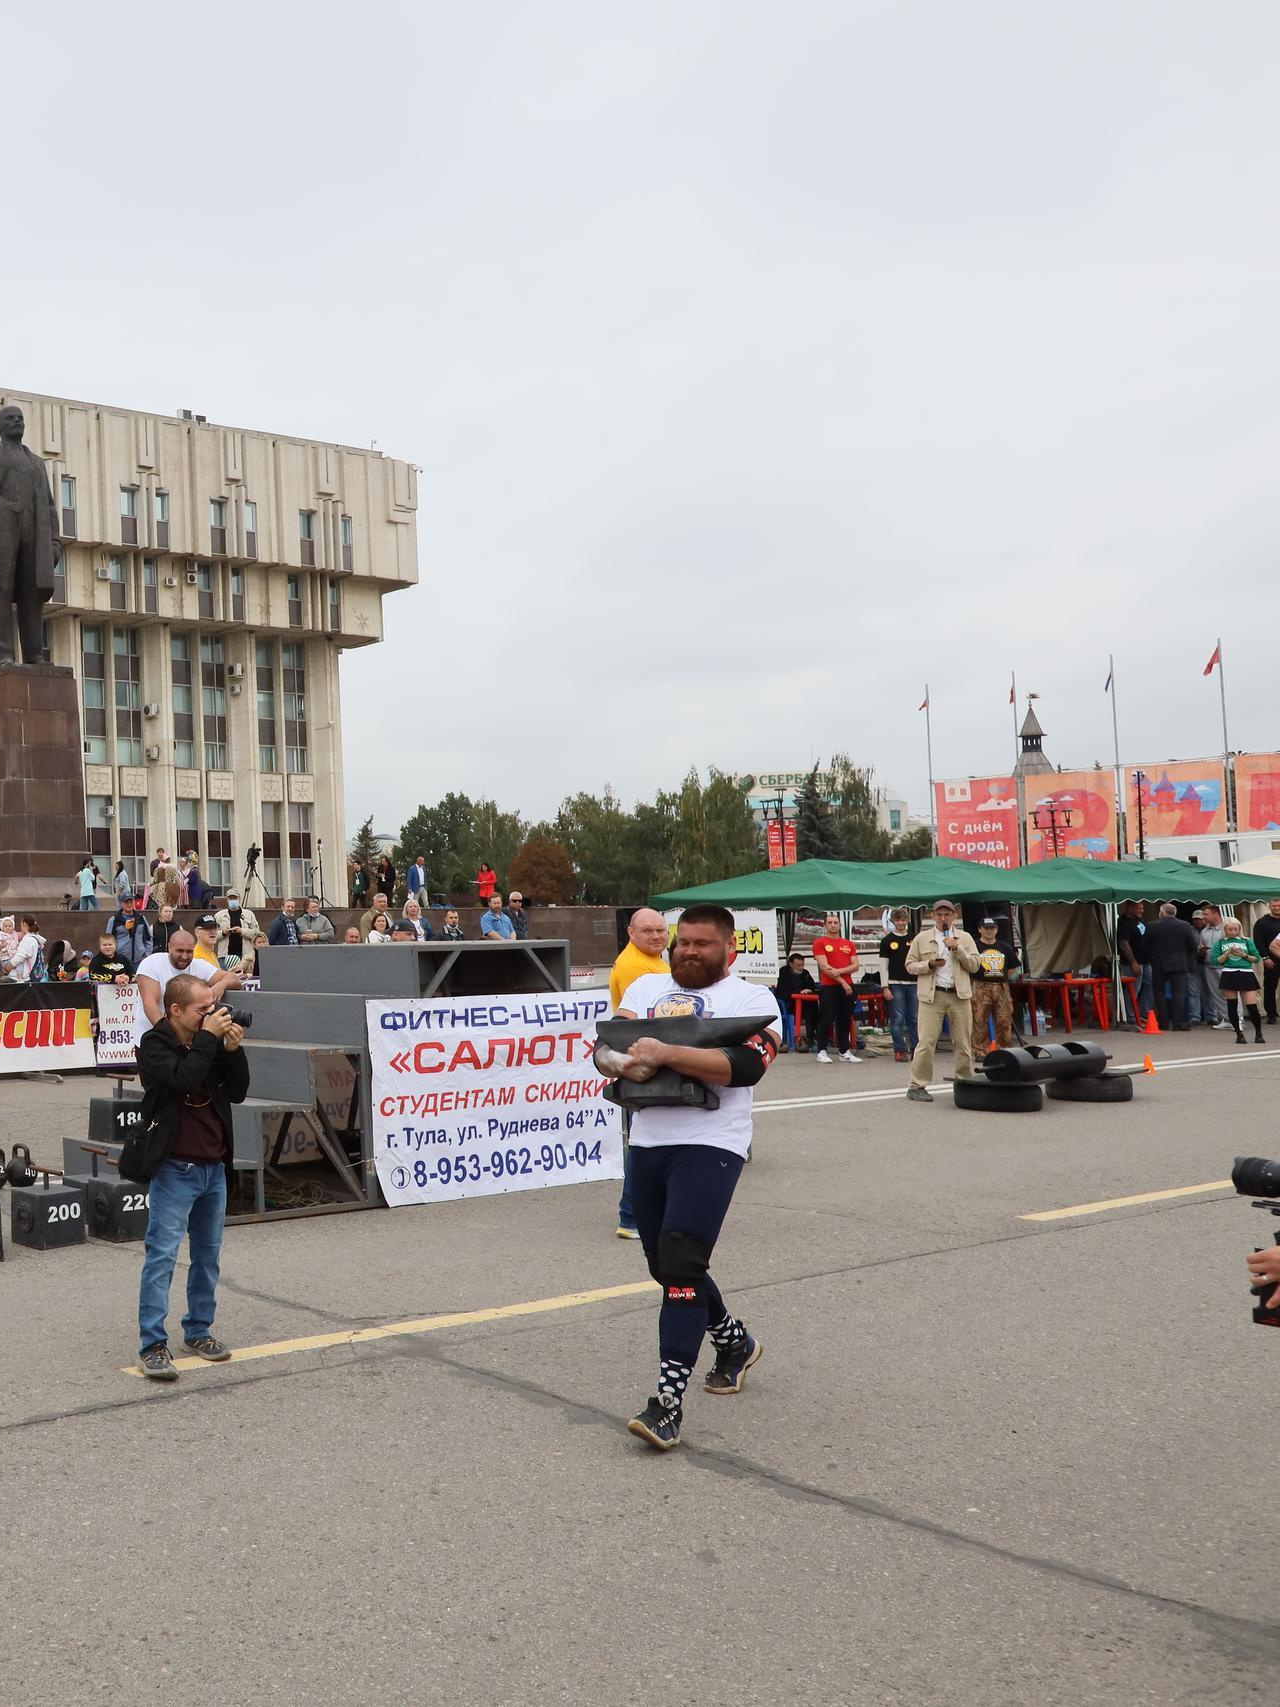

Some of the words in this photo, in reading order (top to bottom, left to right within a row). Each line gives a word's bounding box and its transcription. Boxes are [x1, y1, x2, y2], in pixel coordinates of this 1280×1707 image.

[948, 822, 959, 835] С
[963, 821, 1003, 836] днём
[949, 841, 1009, 855] города,
[115, 988, 134, 1000] 300
[106, 1017, 121, 1025] им.
[380, 1000, 608, 1031] ФИТНЕС-ЦЕНТР
[379, 1086, 516, 1118] СТУДЕНТАМ
[524, 1077, 615, 1104] СКИДКИ
[386, 1134, 398, 1149] г.
[403, 1127, 452, 1151] Тула,
[457, 1125, 483, 1146] ул.
[488, 1115, 560, 1141] Руднева
[413, 1140, 602, 1188] 8-953-962-90-04
[47, 1202, 81, 1223] 200
